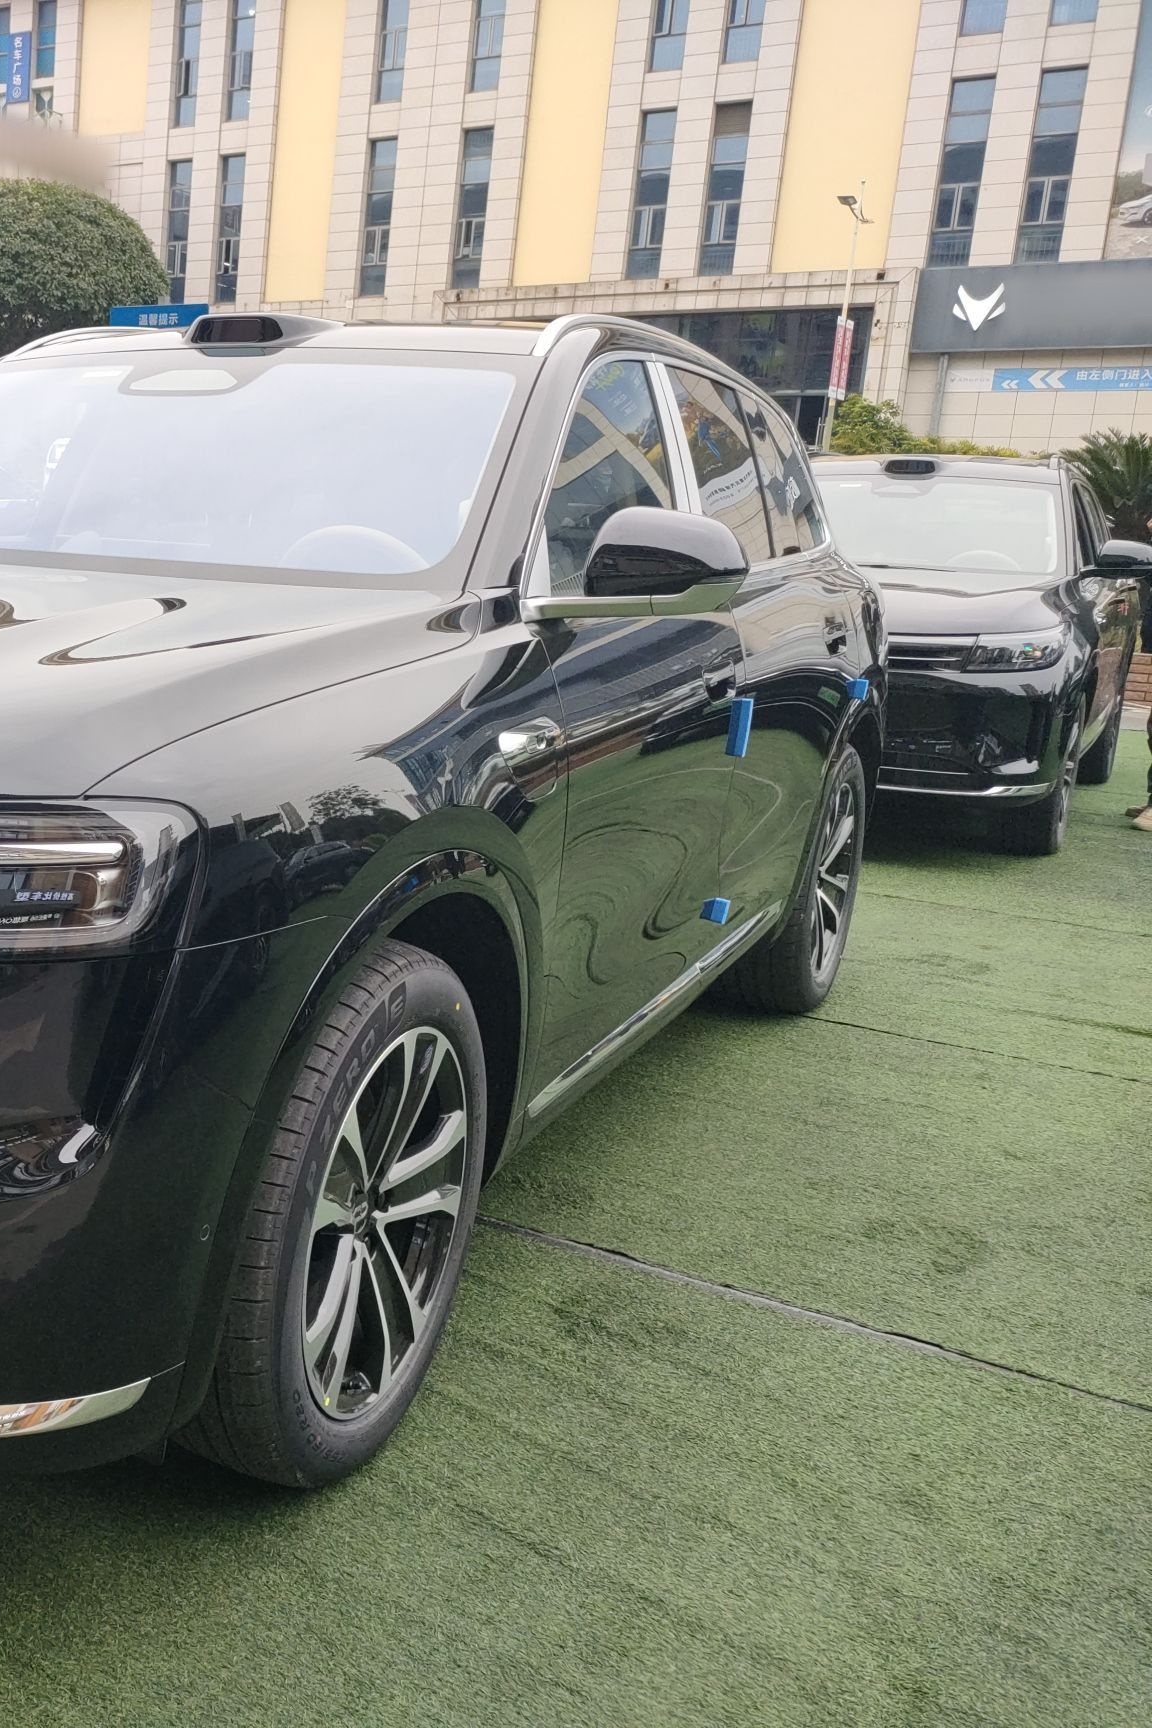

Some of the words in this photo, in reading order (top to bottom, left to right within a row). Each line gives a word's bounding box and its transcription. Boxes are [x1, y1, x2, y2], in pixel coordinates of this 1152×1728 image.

[1076, 367, 1152, 382] 由左侧门进入
